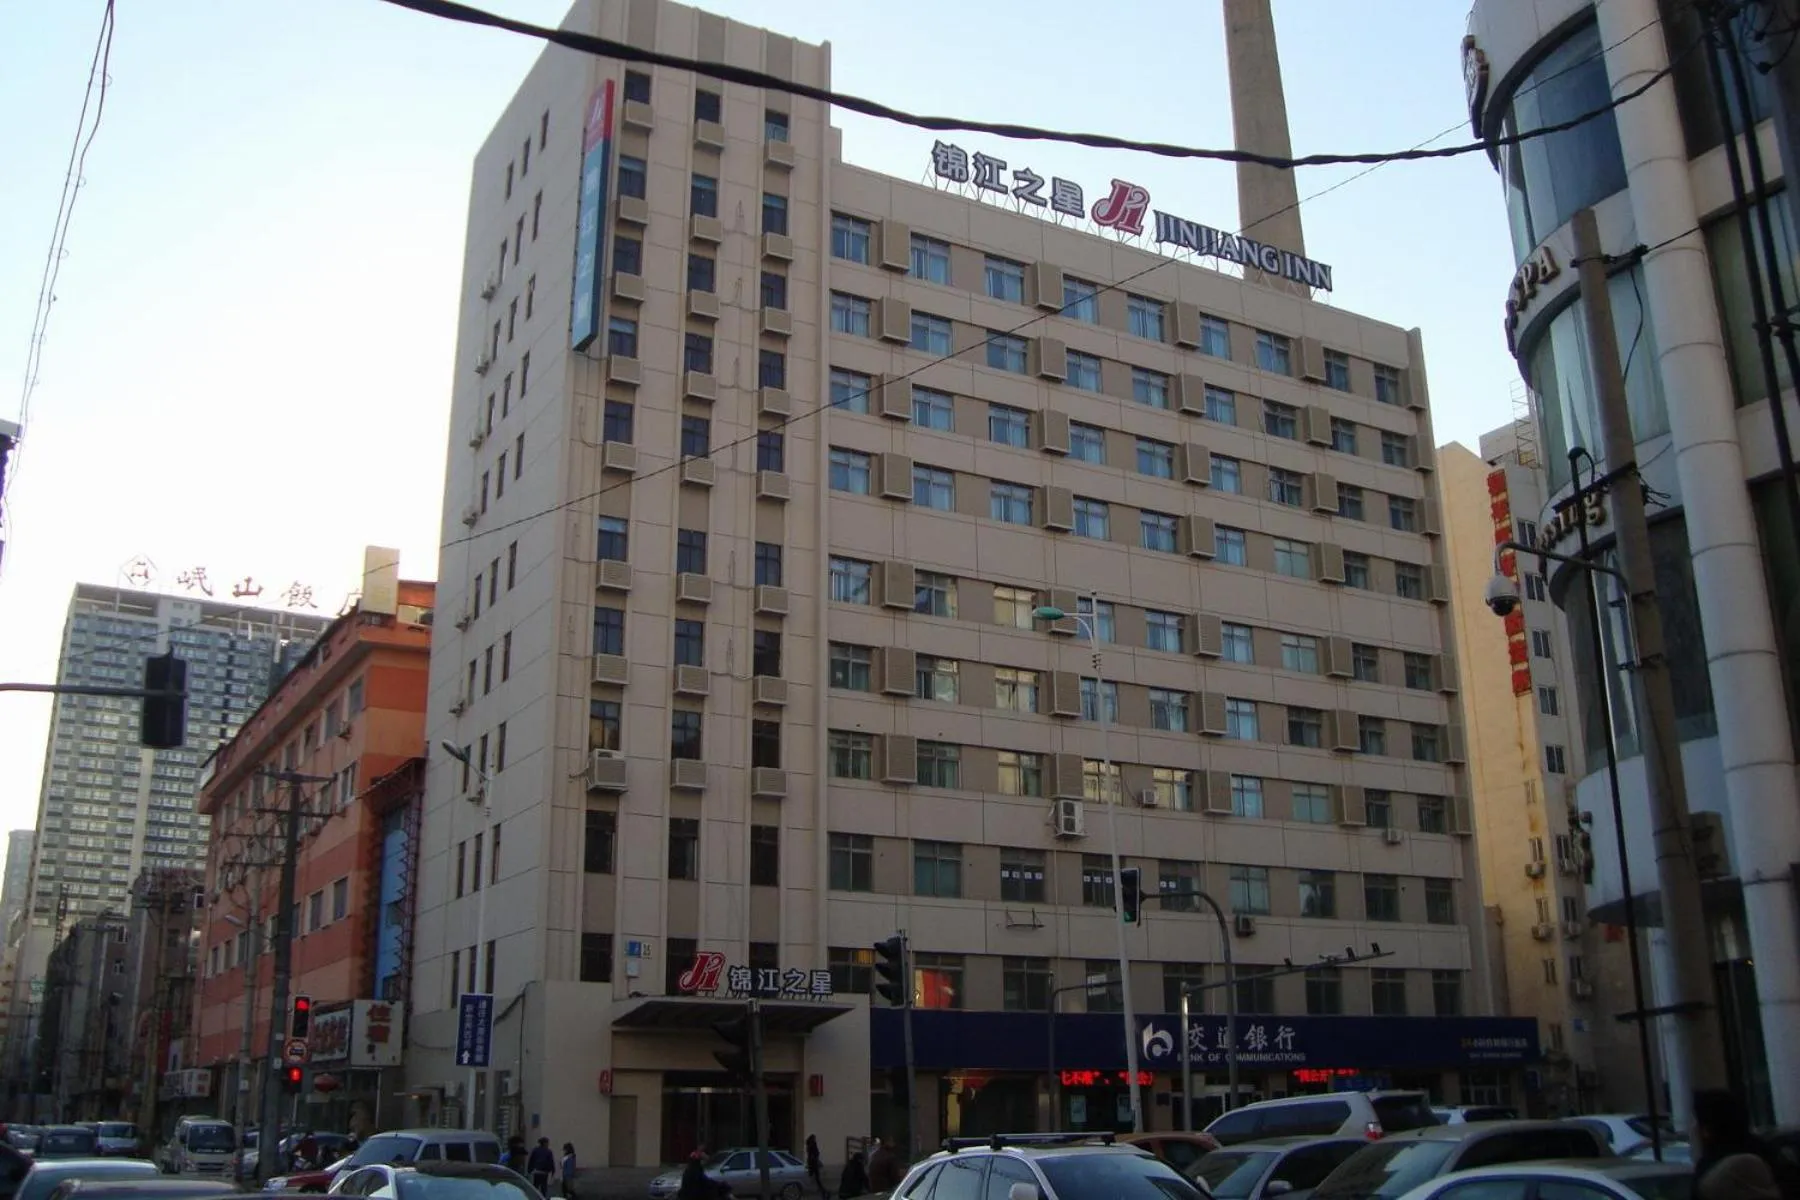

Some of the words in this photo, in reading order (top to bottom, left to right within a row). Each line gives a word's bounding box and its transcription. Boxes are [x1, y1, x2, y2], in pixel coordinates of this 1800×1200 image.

[931, 139, 1085, 219] 锦江之星
[1153, 209, 1282, 275] JINJIANG
[1281, 250, 1333, 292] INN
[728, 964, 834, 996] 锦江之星
[1176, 1052, 1204, 1062] BNK
